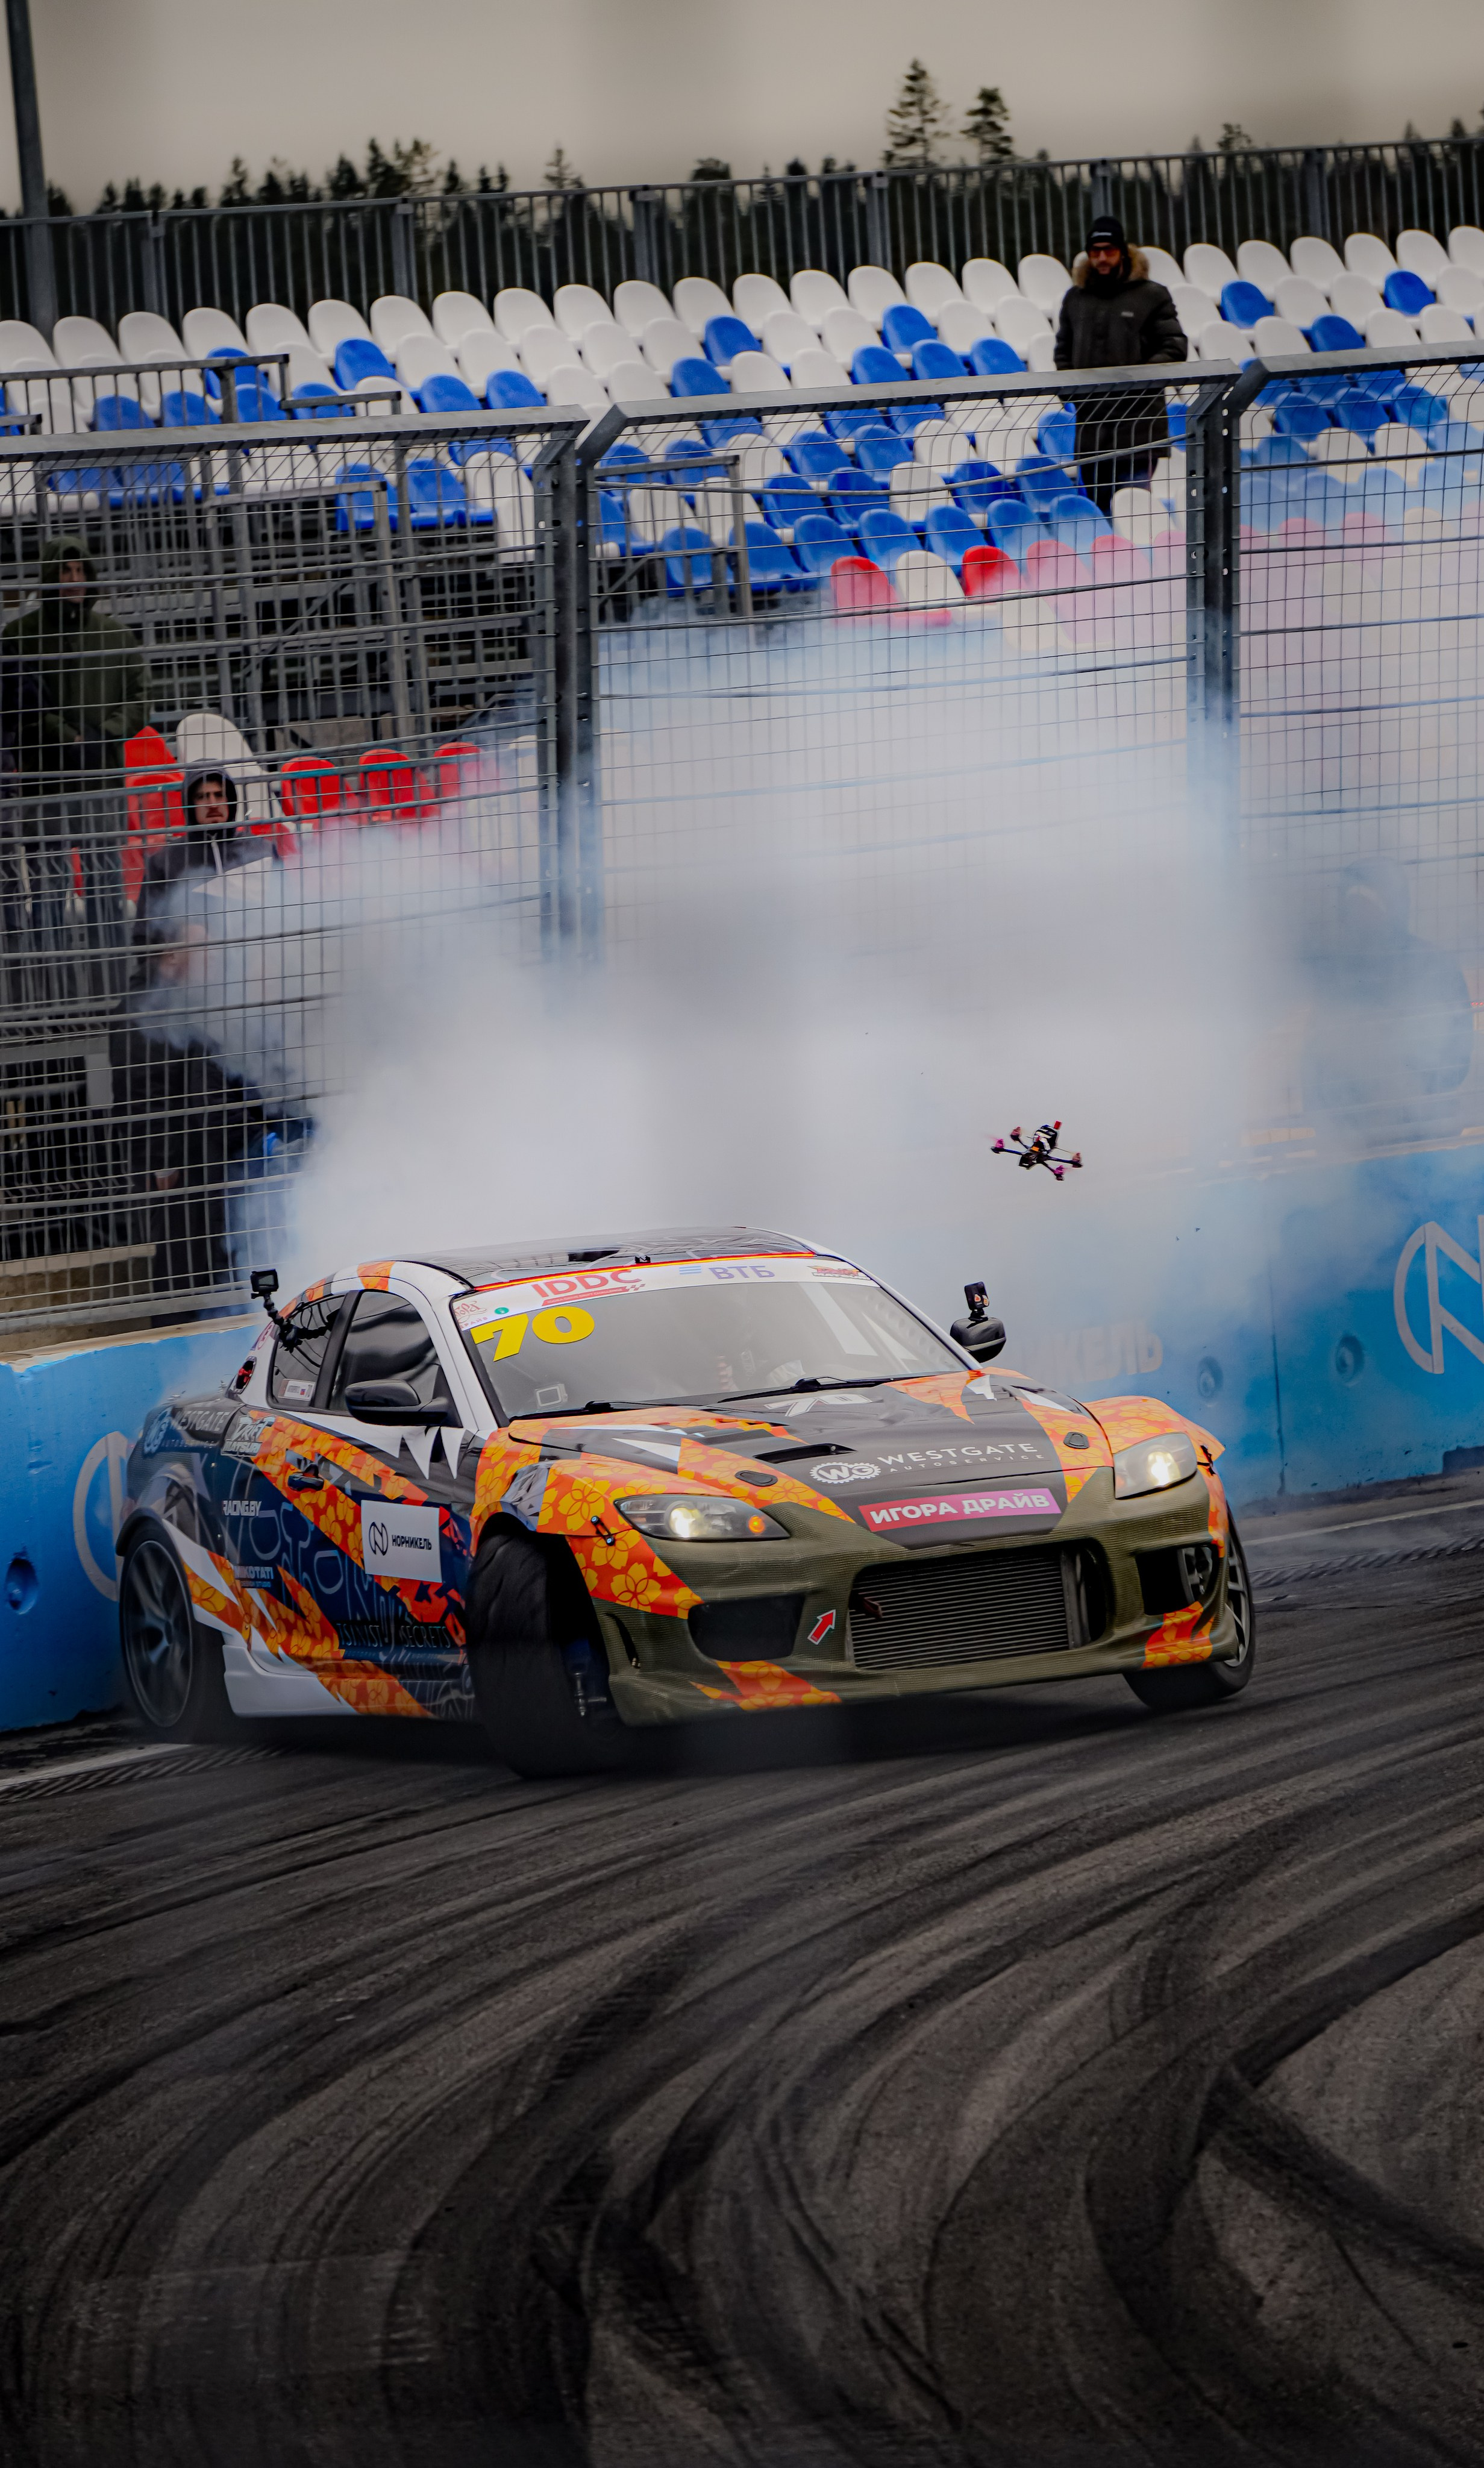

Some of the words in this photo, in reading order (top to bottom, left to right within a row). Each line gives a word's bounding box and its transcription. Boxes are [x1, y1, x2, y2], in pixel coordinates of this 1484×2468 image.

[531, 1269, 642, 1298] IDDC
[708, 1265, 775, 1280] ВТБ
[470, 1306, 595, 1362] 70
[764, 1394, 873, 1417] 70
[877, 1443, 1038, 1465] WESTGATE
[890, 1454, 1045, 1473] AUTOSERVICE
[869, 1503, 959, 1524] ИГОРА
[962, 1492, 1051, 1514] ДРАЙВ
[392, 1535, 432, 1550] НОРНИКЕЛЬ
[400, 1626, 451, 1648] SECRETS
